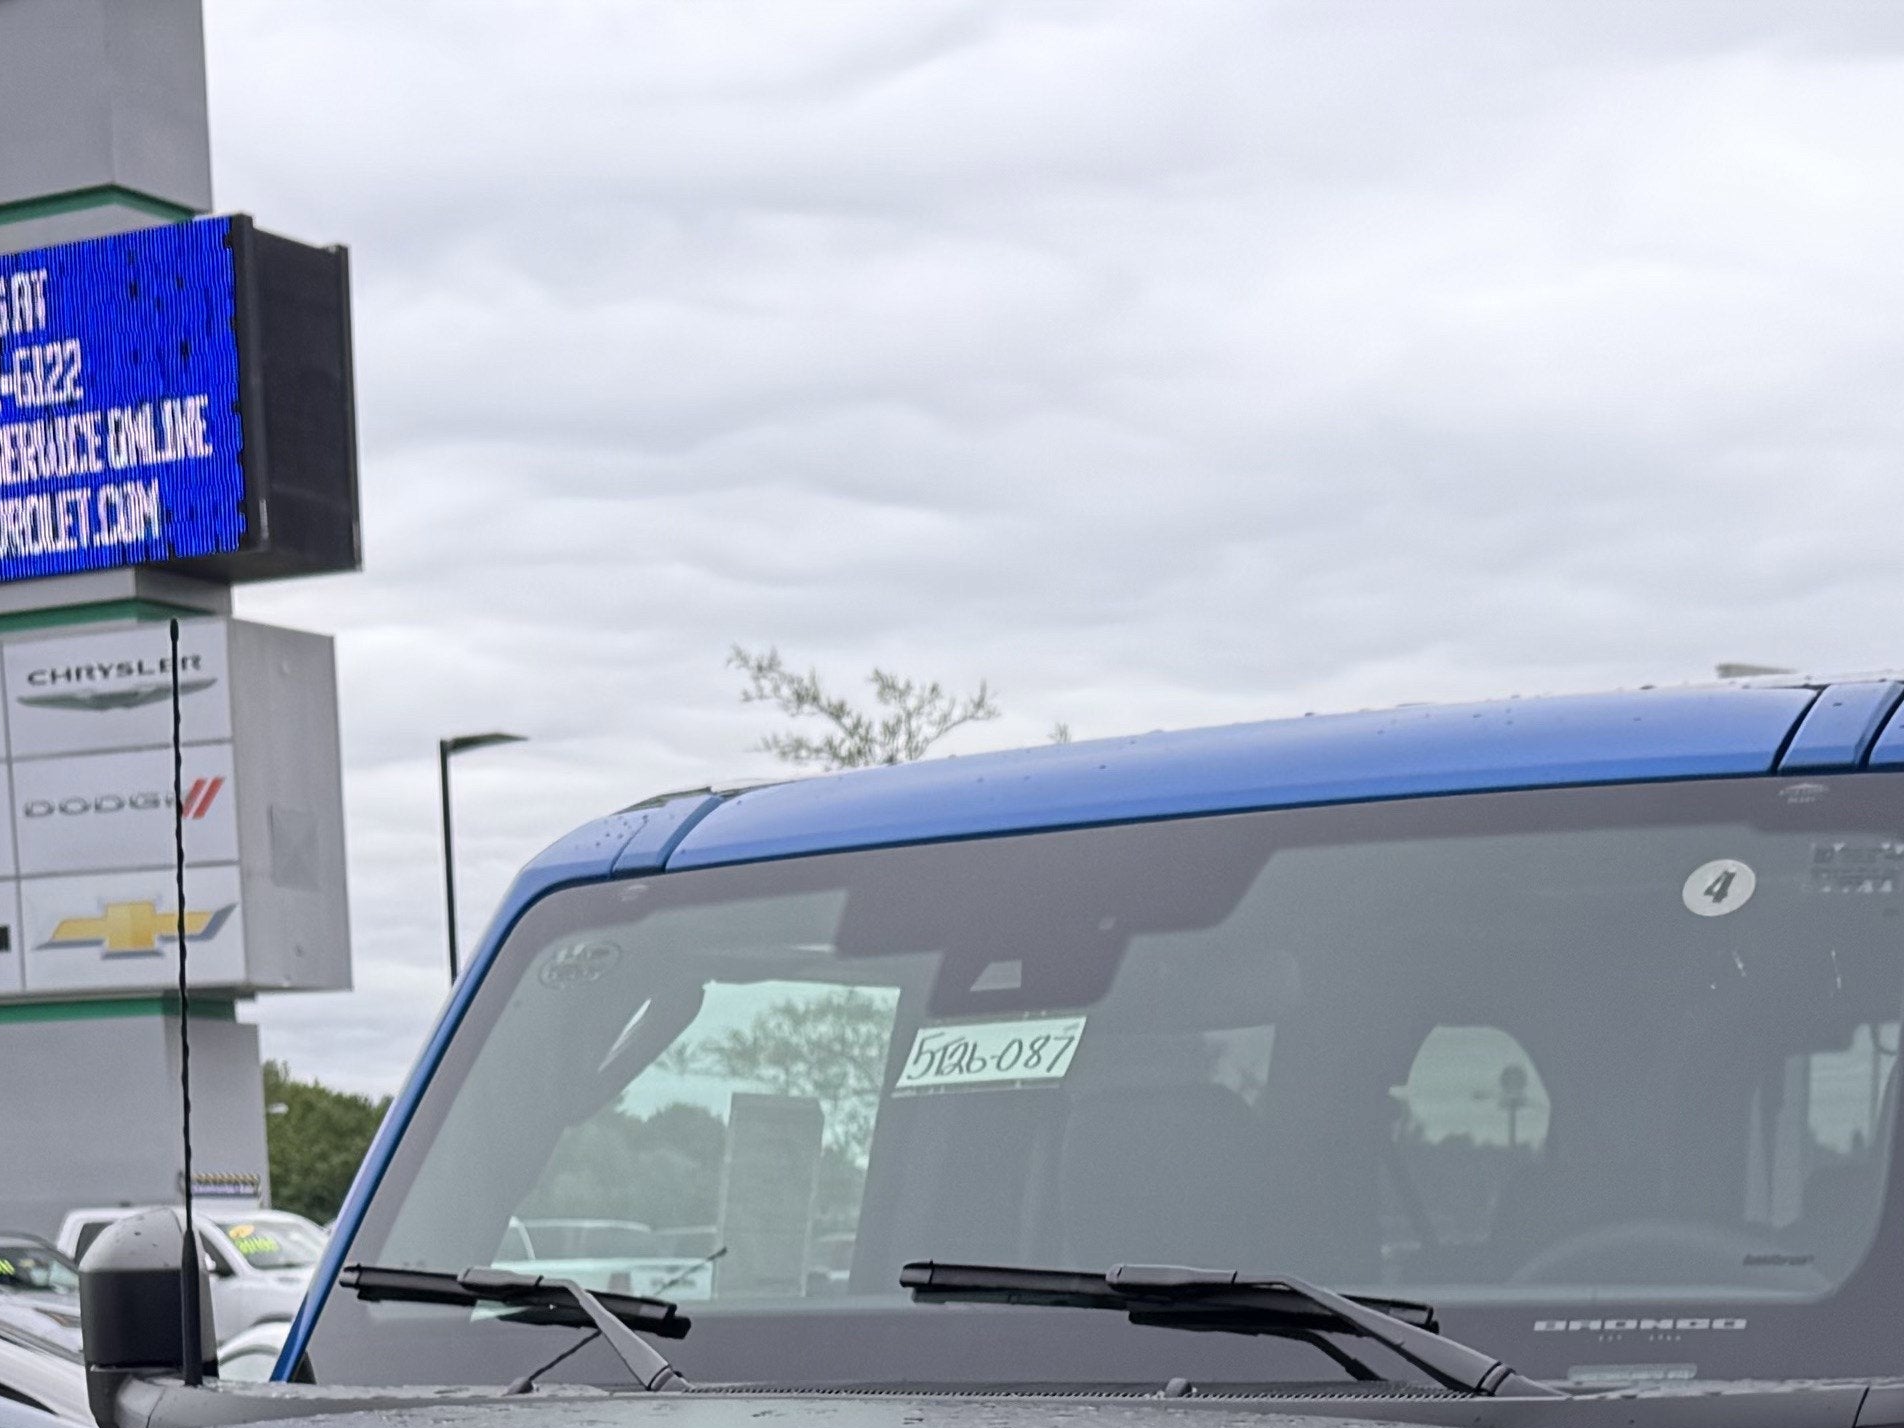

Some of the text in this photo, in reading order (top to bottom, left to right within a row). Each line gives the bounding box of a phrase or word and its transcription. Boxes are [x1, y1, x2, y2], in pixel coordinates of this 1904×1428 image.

[11, 268, 48, 334] AT
[107, 394, 214, 470] ONLINE
[27, 655, 202, 686] CHRYSLER
[1703, 869, 1738, 904] 4
